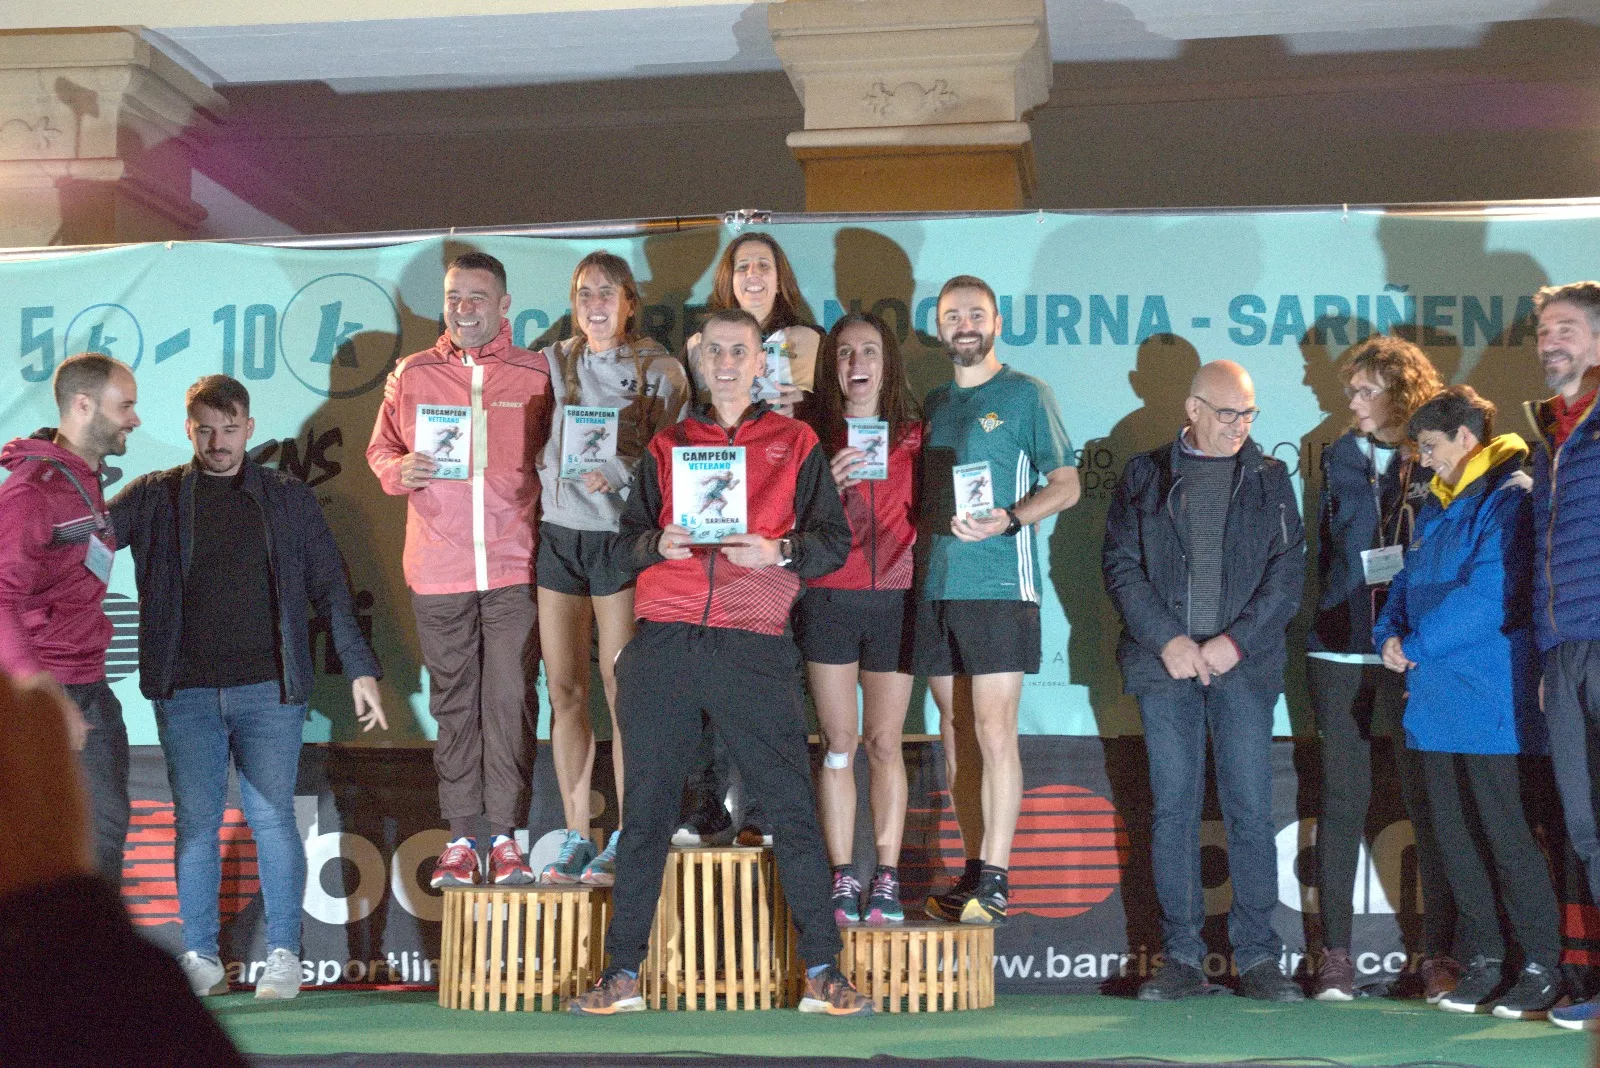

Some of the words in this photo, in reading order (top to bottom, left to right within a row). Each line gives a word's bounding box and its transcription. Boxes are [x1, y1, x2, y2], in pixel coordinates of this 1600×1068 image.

[19, 305, 55, 383] 5
[212, 303, 276, 380] 10
[822, 294, 1175, 348] NOCURNA
[567, 409, 615, 418] SUBCAMPEONA
[682, 450, 736, 461] CAMPEÓN
[688, 462, 731, 471] VETERANO
[681, 514, 688, 527] 5
[705, 517, 740, 525] SARIÑENA
